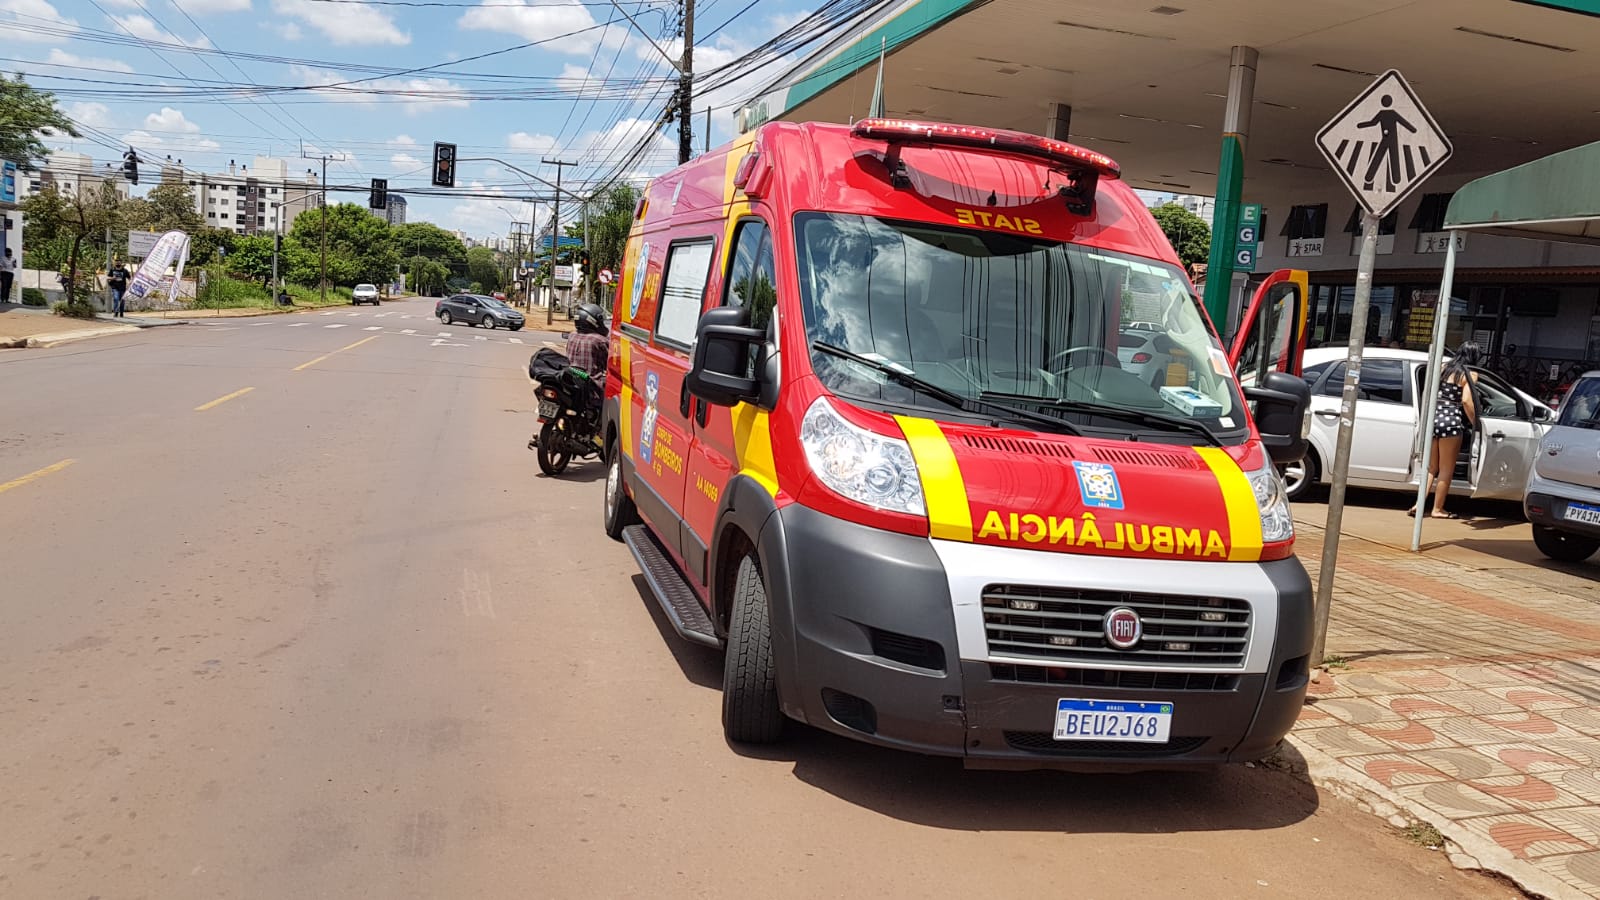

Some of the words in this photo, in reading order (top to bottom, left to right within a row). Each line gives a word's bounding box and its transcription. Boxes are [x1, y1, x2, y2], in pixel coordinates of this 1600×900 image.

[1244, 206, 1256, 220] E
[1240, 228, 1253, 242] G
[1304, 243, 1321, 253] STAR
[1439, 237, 1462, 249] STR
[1237, 250, 1251, 264] G
[654, 440, 682, 475] BOMBEIROS
[1115, 618, 1135, 638] FIAT
[1066, 714, 1158, 737] BEU2J68
